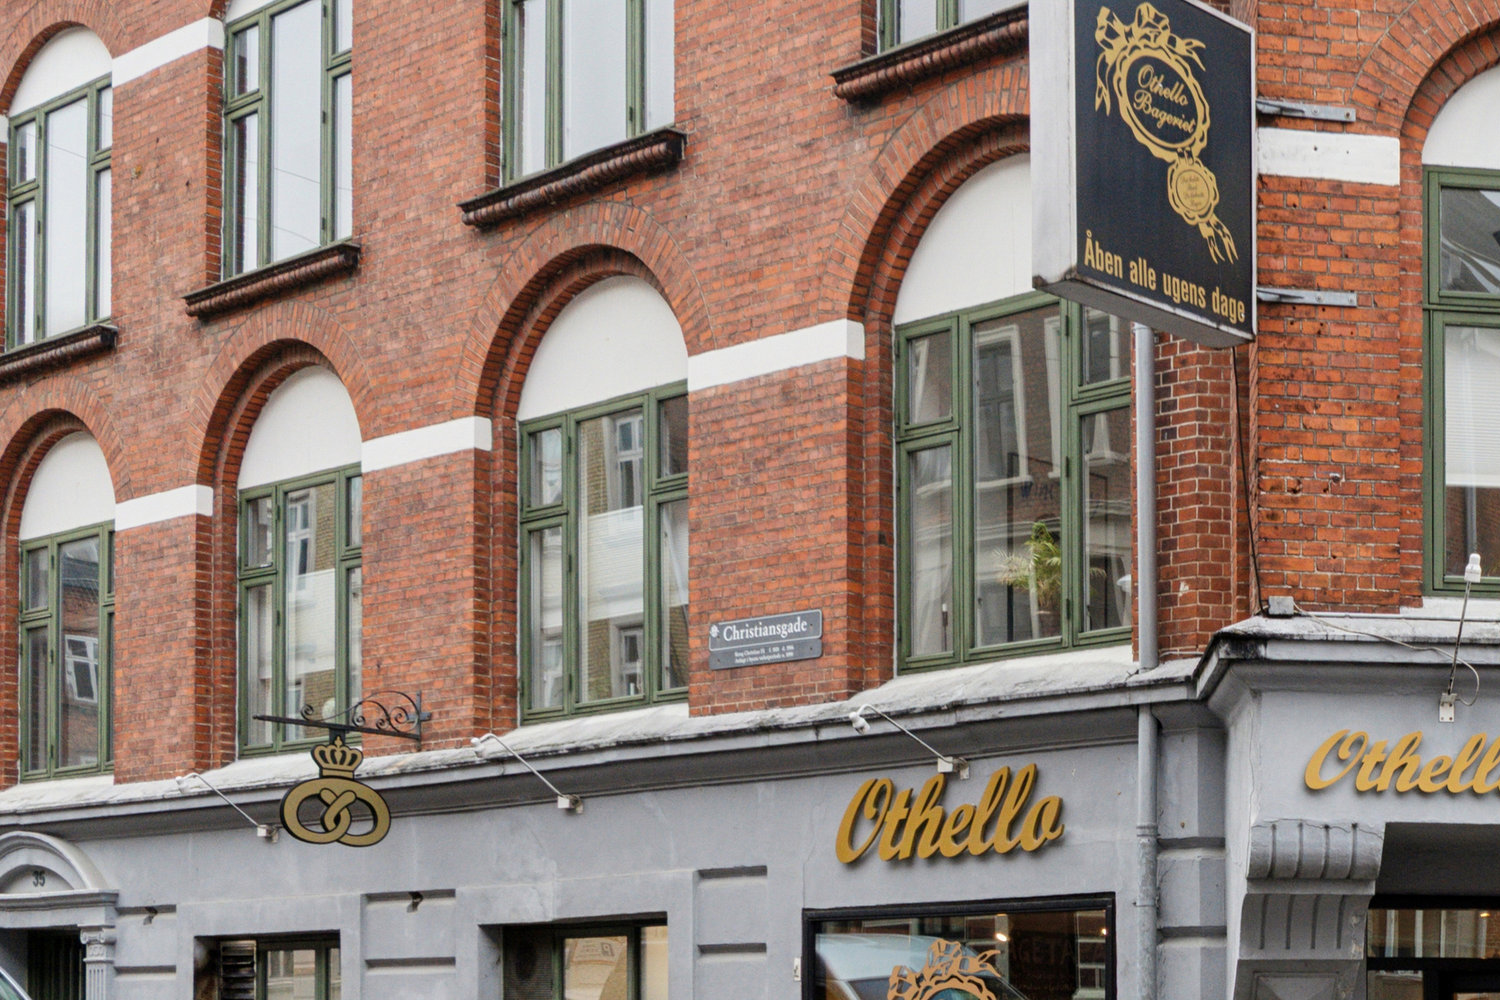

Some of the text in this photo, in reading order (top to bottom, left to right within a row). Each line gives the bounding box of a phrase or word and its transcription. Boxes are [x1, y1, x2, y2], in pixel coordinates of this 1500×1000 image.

[1138, 64, 1188, 106] Othello
[1133, 89, 1196, 133] Bageriet
[1084, 229, 1246, 325] Åben alle ugens dage
[723, 615, 808, 642] Christiansgade
[835, 762, 1065, 864] Othello
[32, 870, 46, 887] 35
